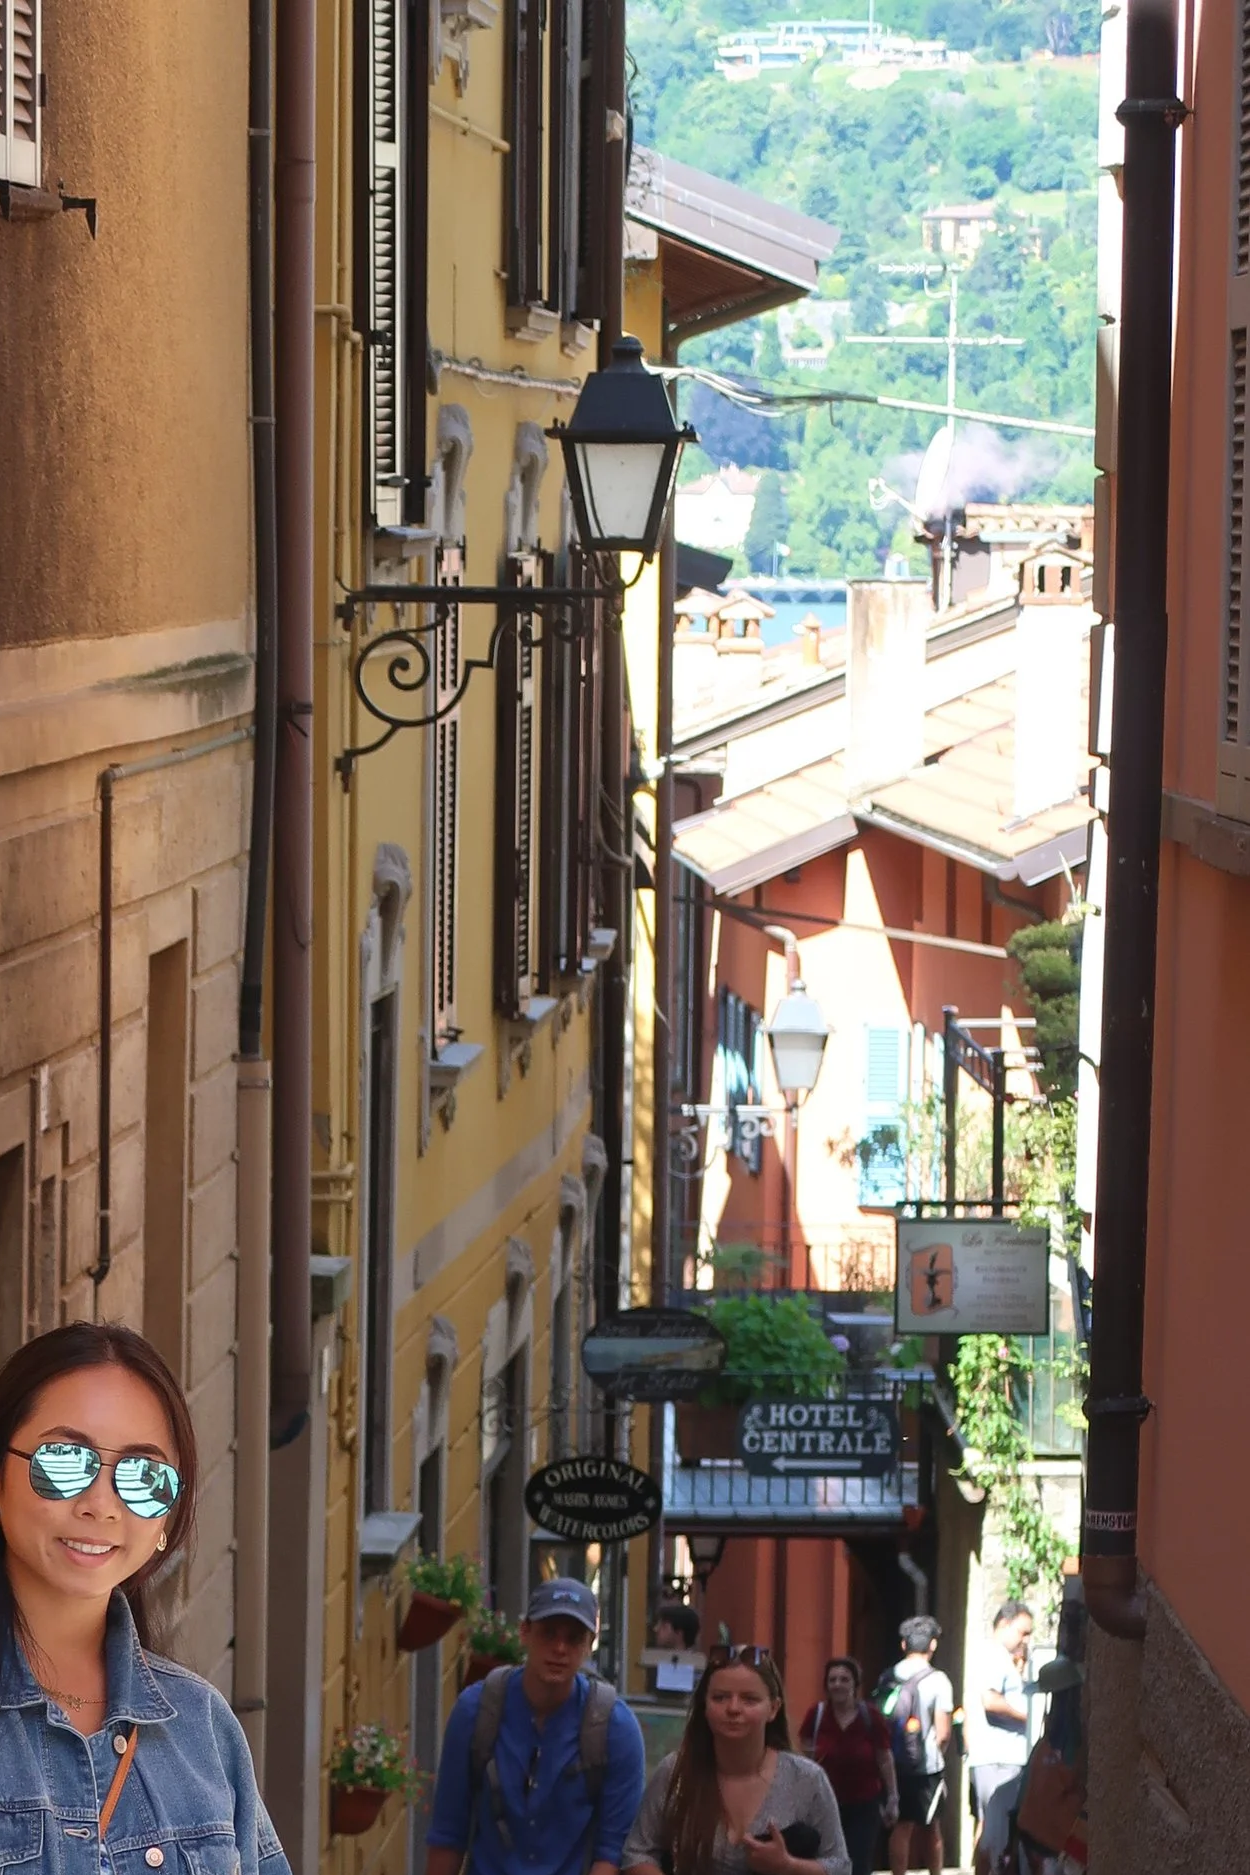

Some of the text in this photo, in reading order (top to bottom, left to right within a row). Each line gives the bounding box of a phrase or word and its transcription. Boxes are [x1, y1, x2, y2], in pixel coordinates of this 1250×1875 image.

[769, 1403, 863, 1428] HOTEL
[742, 1429, 891, 1454] CENTRALE
[544, 1461, 645, 1494] ORIGINAL
[538, 1503, 649, 1540] WATERCOLORS
